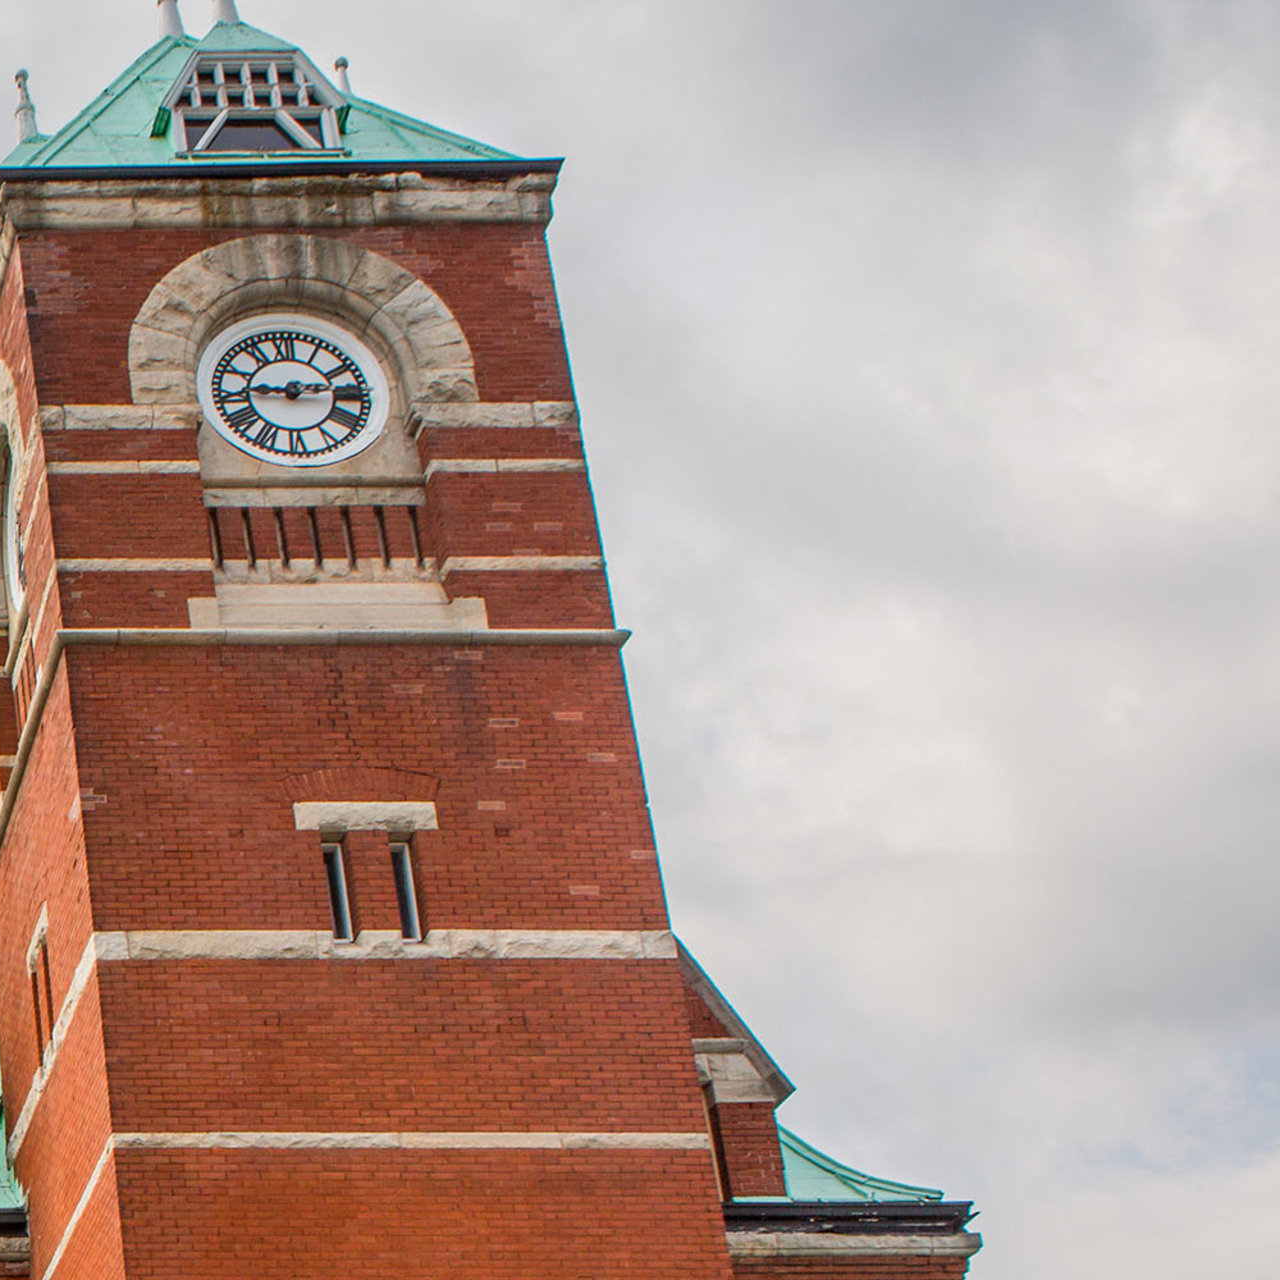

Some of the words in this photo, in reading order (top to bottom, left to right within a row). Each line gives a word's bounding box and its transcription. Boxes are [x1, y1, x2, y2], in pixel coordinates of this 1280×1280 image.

[245, 345, 270, 366] XI
[273, 339, 295, 361] XII
[307, 343, 320, 364] I
[224, 363, 253, 379] X
[324, 362, 349, 380] II
[221, 389, 249, 402] IX
[227, 406, 260, 433] VIII
[255, 423, 279, 449] VII
[290, 430, 307, 452] VI
[319, 426, 340, 448] V
